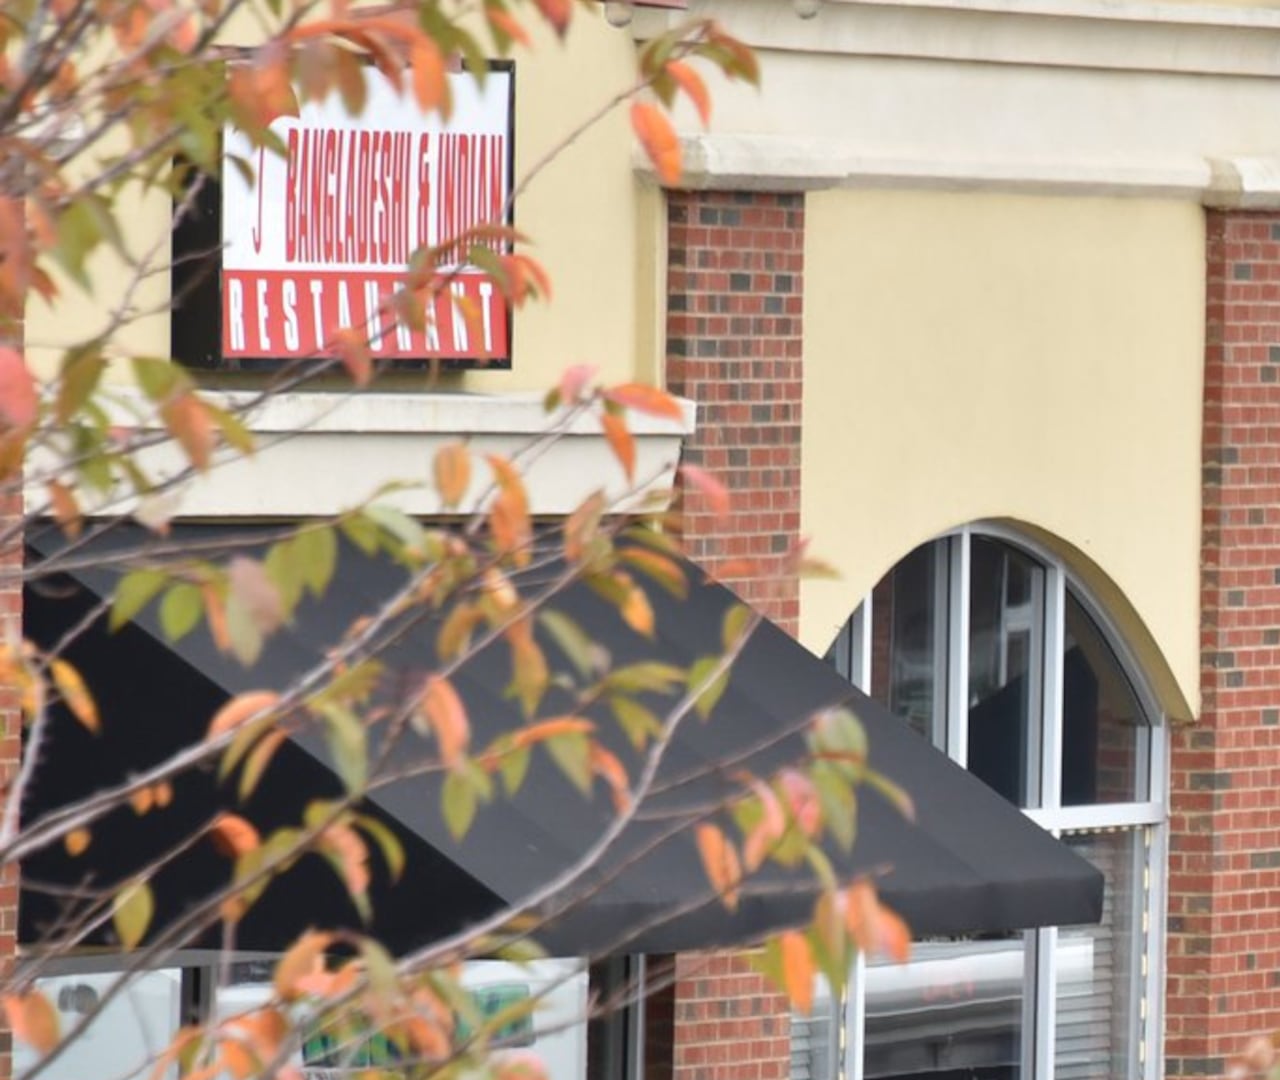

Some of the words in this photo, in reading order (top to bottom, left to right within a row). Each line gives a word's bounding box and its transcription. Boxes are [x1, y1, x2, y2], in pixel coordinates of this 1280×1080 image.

[286, 127, 413, 265] BANGLADESHI
[417, 132, 430, 252] &
[437, 132, 504, 265] INDIAN
[228, 277, 494, 353] RESTAURANT
